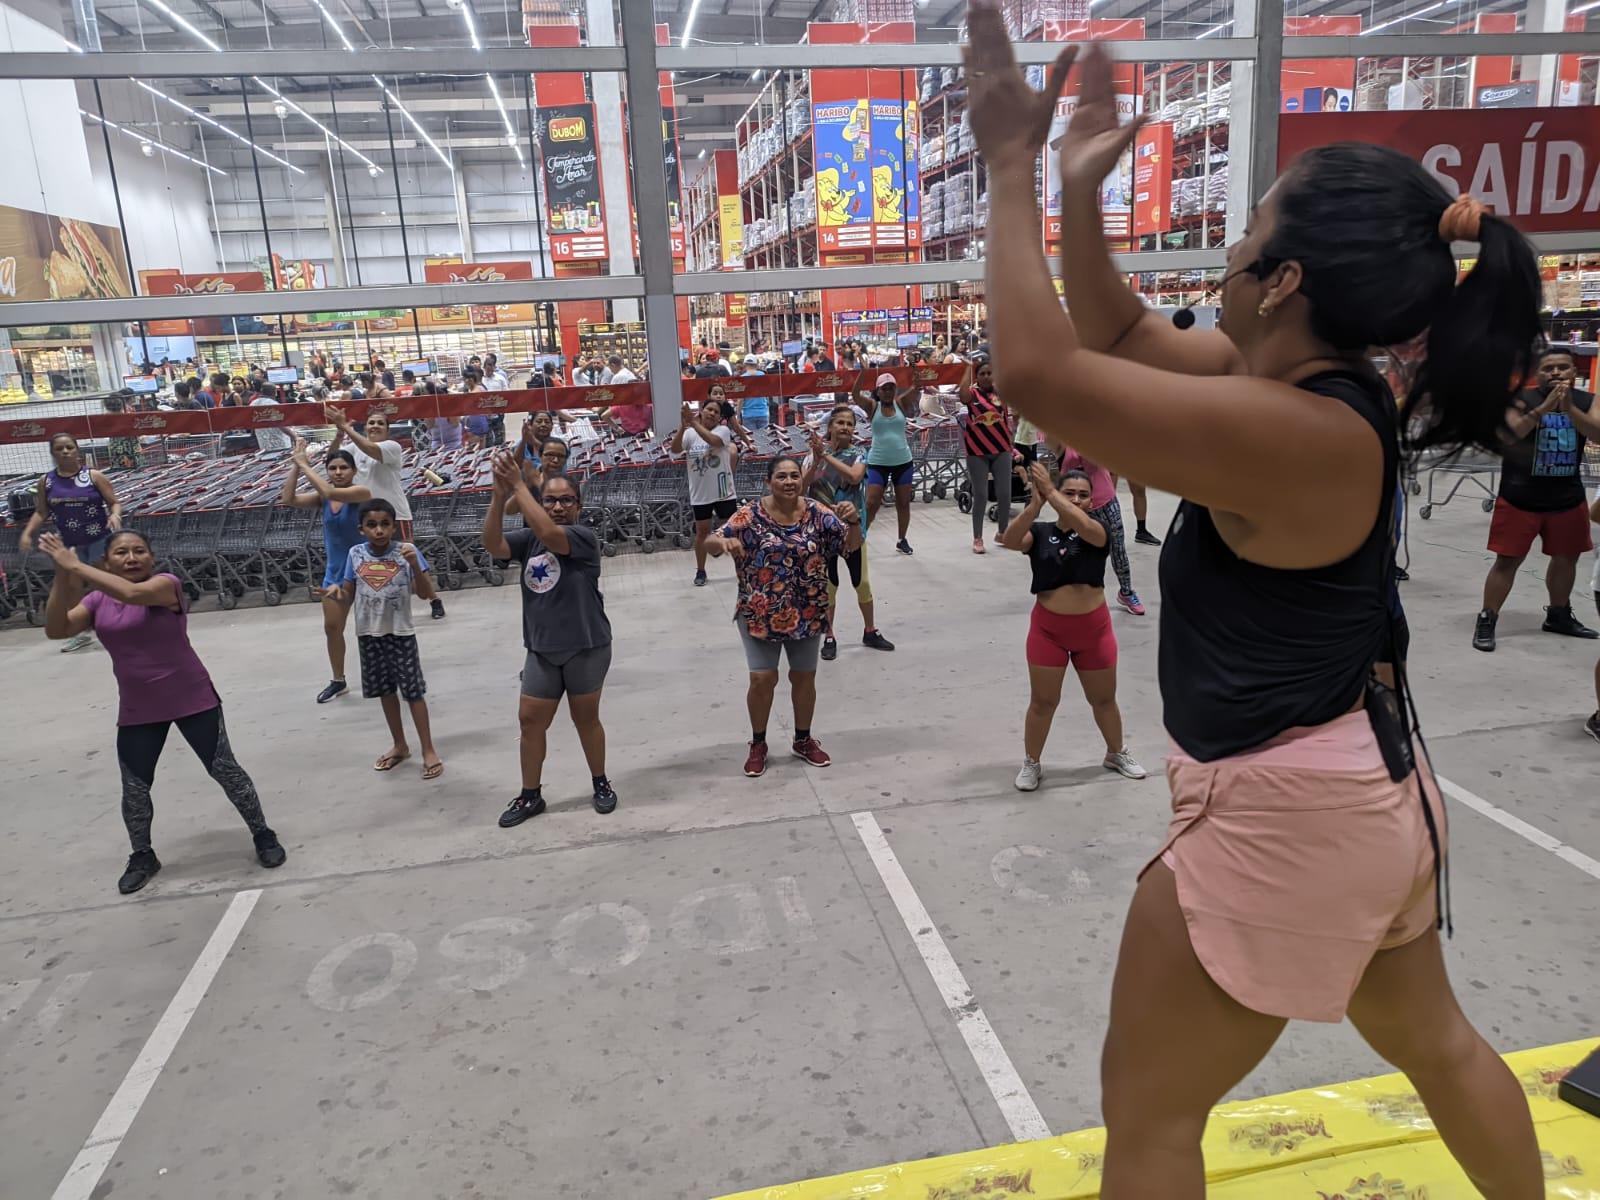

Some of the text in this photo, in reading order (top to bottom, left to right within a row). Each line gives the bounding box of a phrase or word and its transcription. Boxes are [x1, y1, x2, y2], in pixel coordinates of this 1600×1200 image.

[816, 107, 850, 118] HARIBO
[552, 121, 583, 138] DUBOM
[1050, 223, 1061, 233] 12
[822, 233, 834, 244] 14
[908, 229, 917, 239] 13
[554, 242, 569, 255] 16
